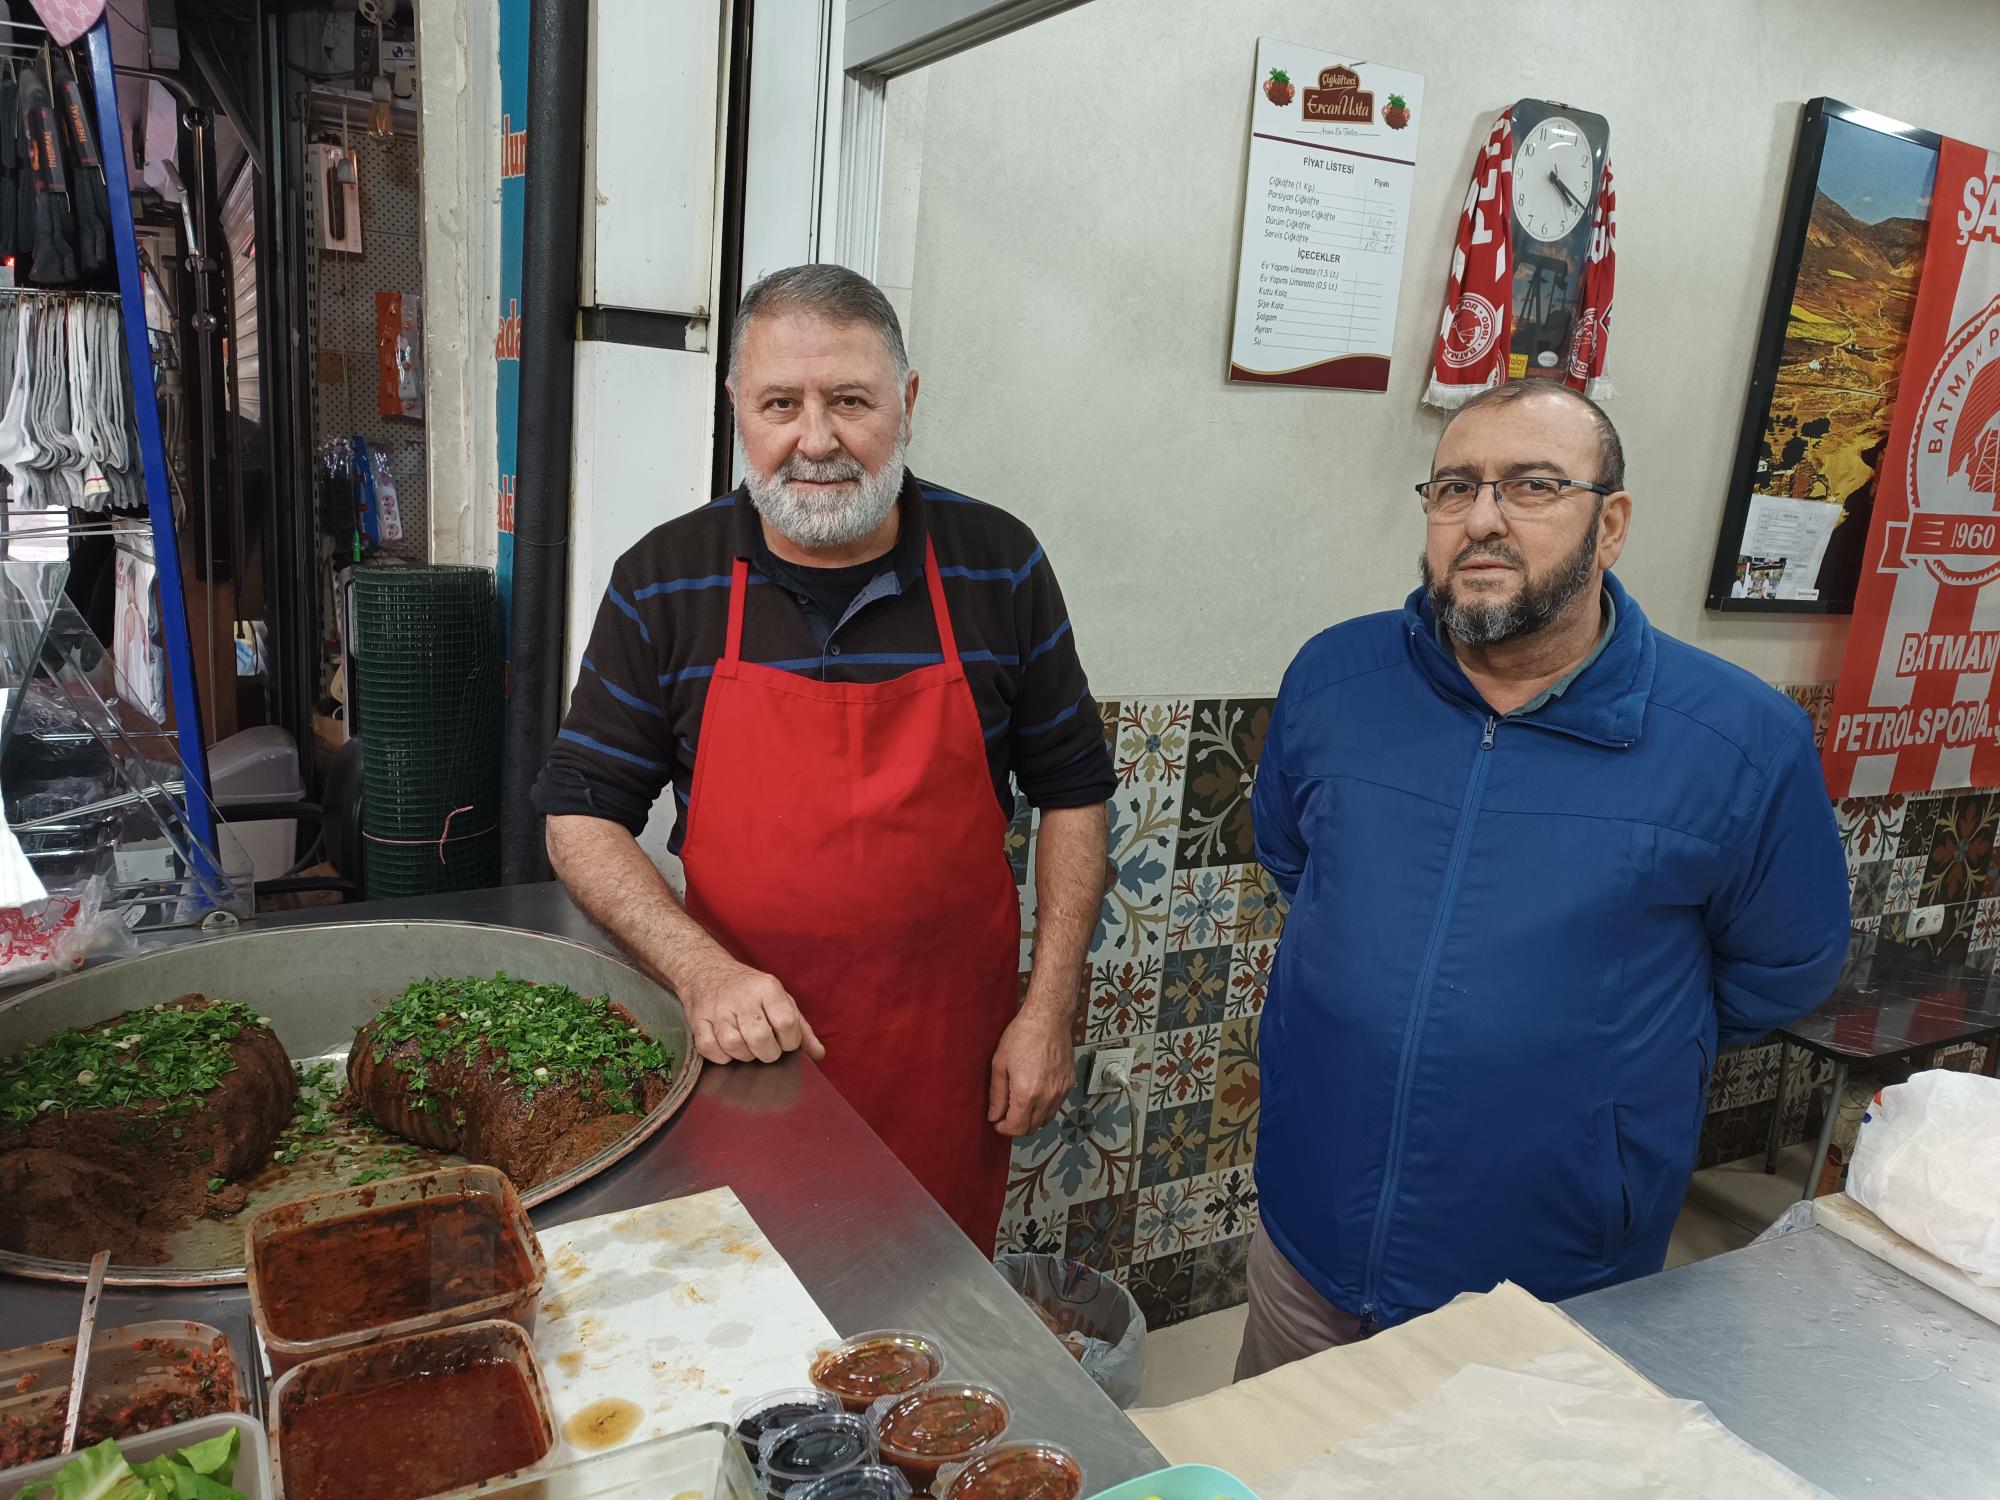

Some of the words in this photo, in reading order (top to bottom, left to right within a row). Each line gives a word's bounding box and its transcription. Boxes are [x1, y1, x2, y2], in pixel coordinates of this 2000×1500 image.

[1307, 94, 1341, 115] Ercan
[1340, 95, 1370, 117] Usta
[70, 103, 88, 143] THERMAL
[1540, 128, 1548, 141] 11
[43, 129, 57, 168] THERMAL
[1525, 143, 1535, 157] 10
[1303, 157, 1325, 171] FİYAT
[1325, 160, 1355, 174] LİSTESİ
[1581, 154, 1589, 168] 2
[1517, 167, 1524, 180] 9
[1582, 181, 1588, 193] 3
[1267, 189, 1294, 201] Porsiyon
[1518, 193, 1525, 207] 8
[1285, 205, 1311, 217] Porsiyon
[1571, 204, 1579, 216] 4
[1265, 215, 1285, 226] Dürüm
[1527, 214, 1535, 227] 7
[1559, 220, 1566, 233] 5
[1264, 228, 1283, 239] Servis
[1541, 223, 1548, 235] 6
[1297, 247, 1341, 263] İÇECEKLER
[1261, 261, 1269, 269] Ev
[1290, 265, 1316, 276] Limonata
[1259, 273, 1268, 282] Ev
[1289, 277, 1315, 289] Limonata
[1259, 287, 1273, 296] Kutu
[1274, 289, 1288, 298] Kola
[1271, 301, 1284, 310] Kola
[1254, 324, 1273, 335] Ayran
[1253, 336, 1262, 346] Su
[1927, 342, 1983, 454] BATMAN
[1949, 522, 1996, 550] 1960
[1899, 634, 1999, 675] BATMAN
